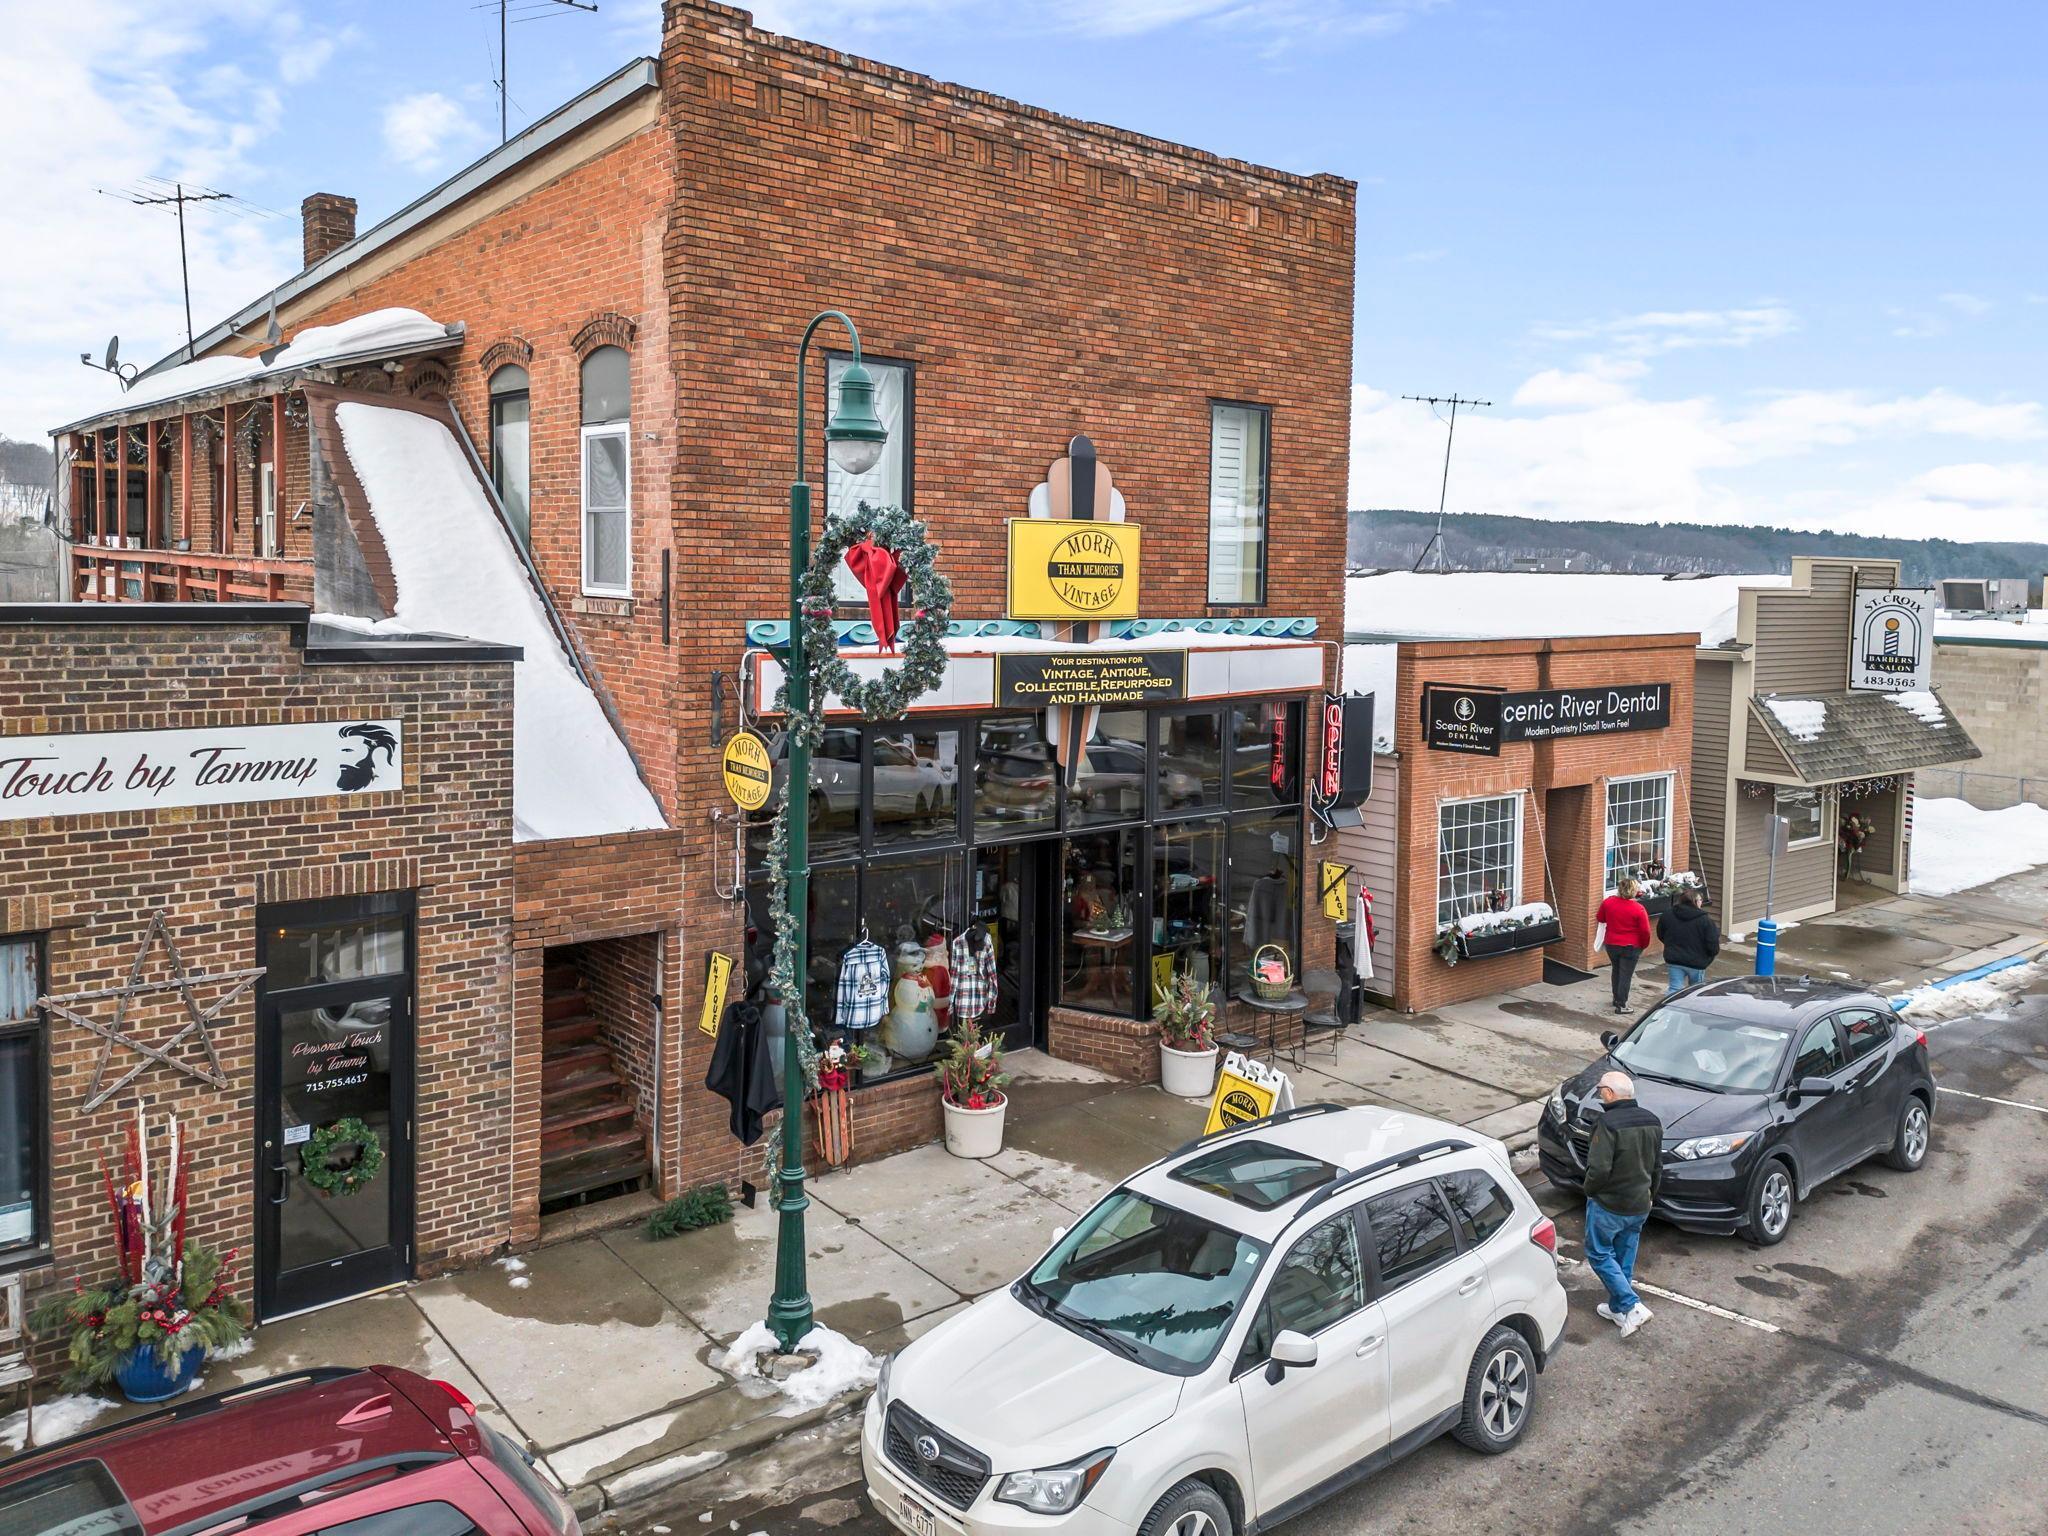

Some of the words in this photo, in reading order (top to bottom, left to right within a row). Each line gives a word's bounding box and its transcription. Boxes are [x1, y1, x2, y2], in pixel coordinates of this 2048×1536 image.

[1066, 533, 1114, 558] MORH
[1058, 563, 1082, 575] THAN
[1083, 564, 1119, 576] MEMORIES
[1062, 582, 1116, 606] VINTAGE
[1864, 598, 1882, 612] ST.
[1882, 595, 1926, 614] CROIX
[1868, 655, 1913, 664] BARBERS
[1879, 664, 1911, 672] SALON
[1863, 676, 1916, 688] 483-9565
[1501, 699, 1554, 722] cenic
[1560, 694, 1603, 718] River
[1607, 686, 1661, 714] Dental
[1435, 719, 1468, 732] Scenic
[1470, 722, 1494, 735] River
[1448, 732, 1479, 741] DENTAL
[1525, 725, 1550, 736] Modern
[1551, 724, 1579, 735] Dentistry
[1582, 721, 1600, 732] Small
[1601, 720, 1616, 730] Town
[1616, 718, 1630, 728] Feel
[735, 740, 761, 763] MORH
[1325, 704, 1342, 796] OPEN
[0, 757, 114, 799] Touch
[125, 754, 175, 797] by
[190, 747, 318, 787] Tammy
[732, 777, 762, 801] VINTAGE
[1326, 868, 1345, 916] VITAGE
[299, 927, 365, 978] 111
[711, 956, 719, 1034] ANTIQUES
[291, 1034, 349, 1057] Personal
[350, 1030, 383, 1048] Touch
[306, 1061, 323, 1075] by
[326, 1054, 368, 1071] Tammy
[305, 1073, 369, 1093] 715.755.4617
[1231, 1094, 1255, 1112] MORH
